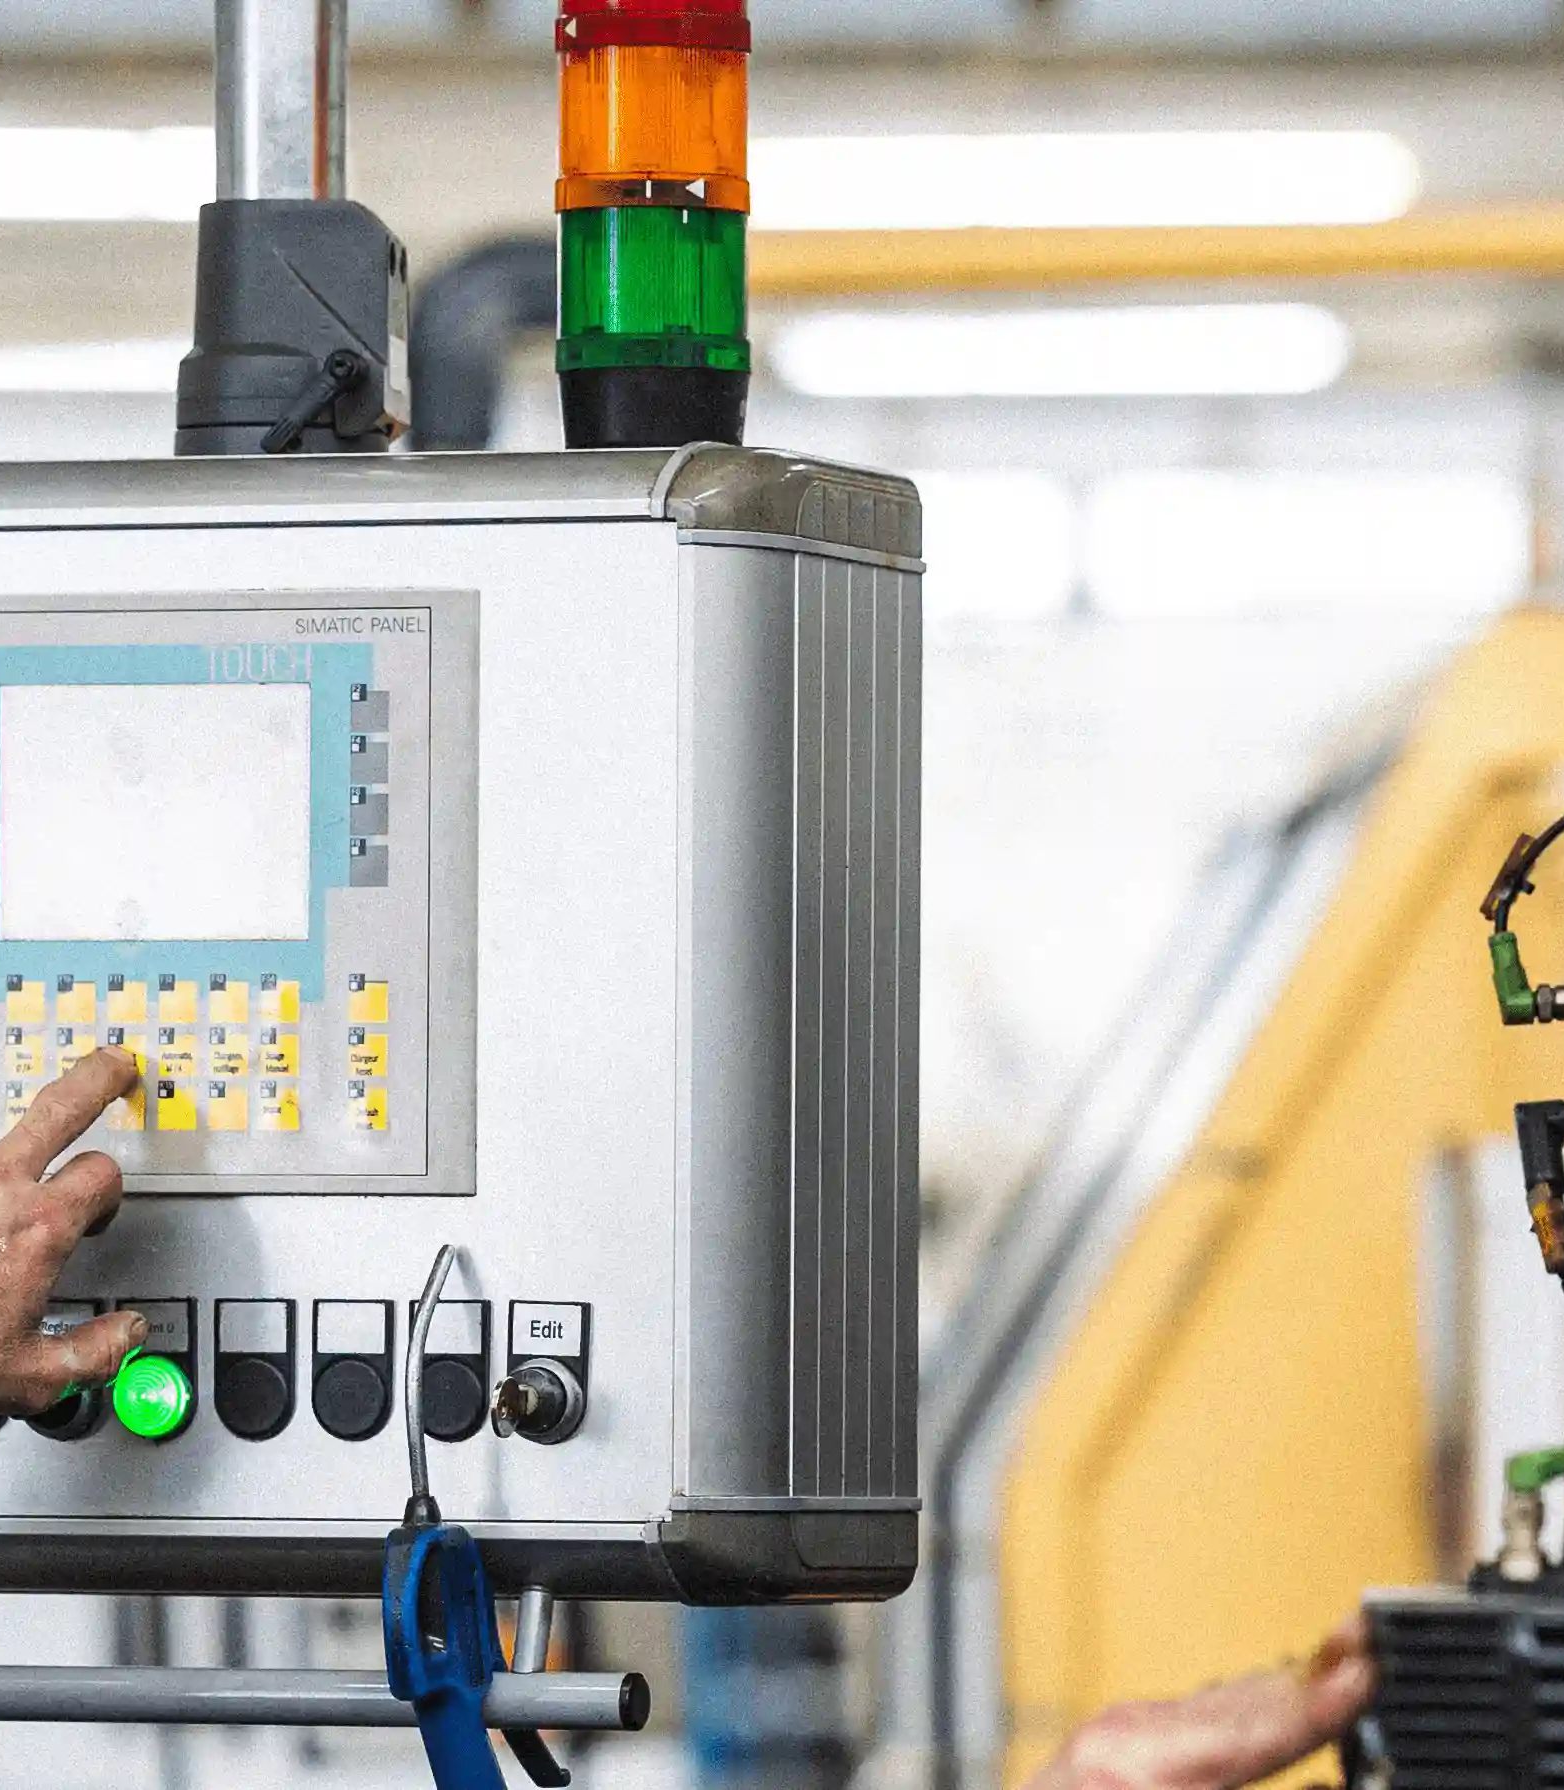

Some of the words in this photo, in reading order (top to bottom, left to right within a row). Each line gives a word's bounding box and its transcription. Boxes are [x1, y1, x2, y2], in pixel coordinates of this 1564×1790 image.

[295, 617, 364, 634] SIMATIC
[371, 616, 426, 632] PANEL
[207, 643, 312, 681] TOUCH
[530, 1319, 563, 1339] Edit
